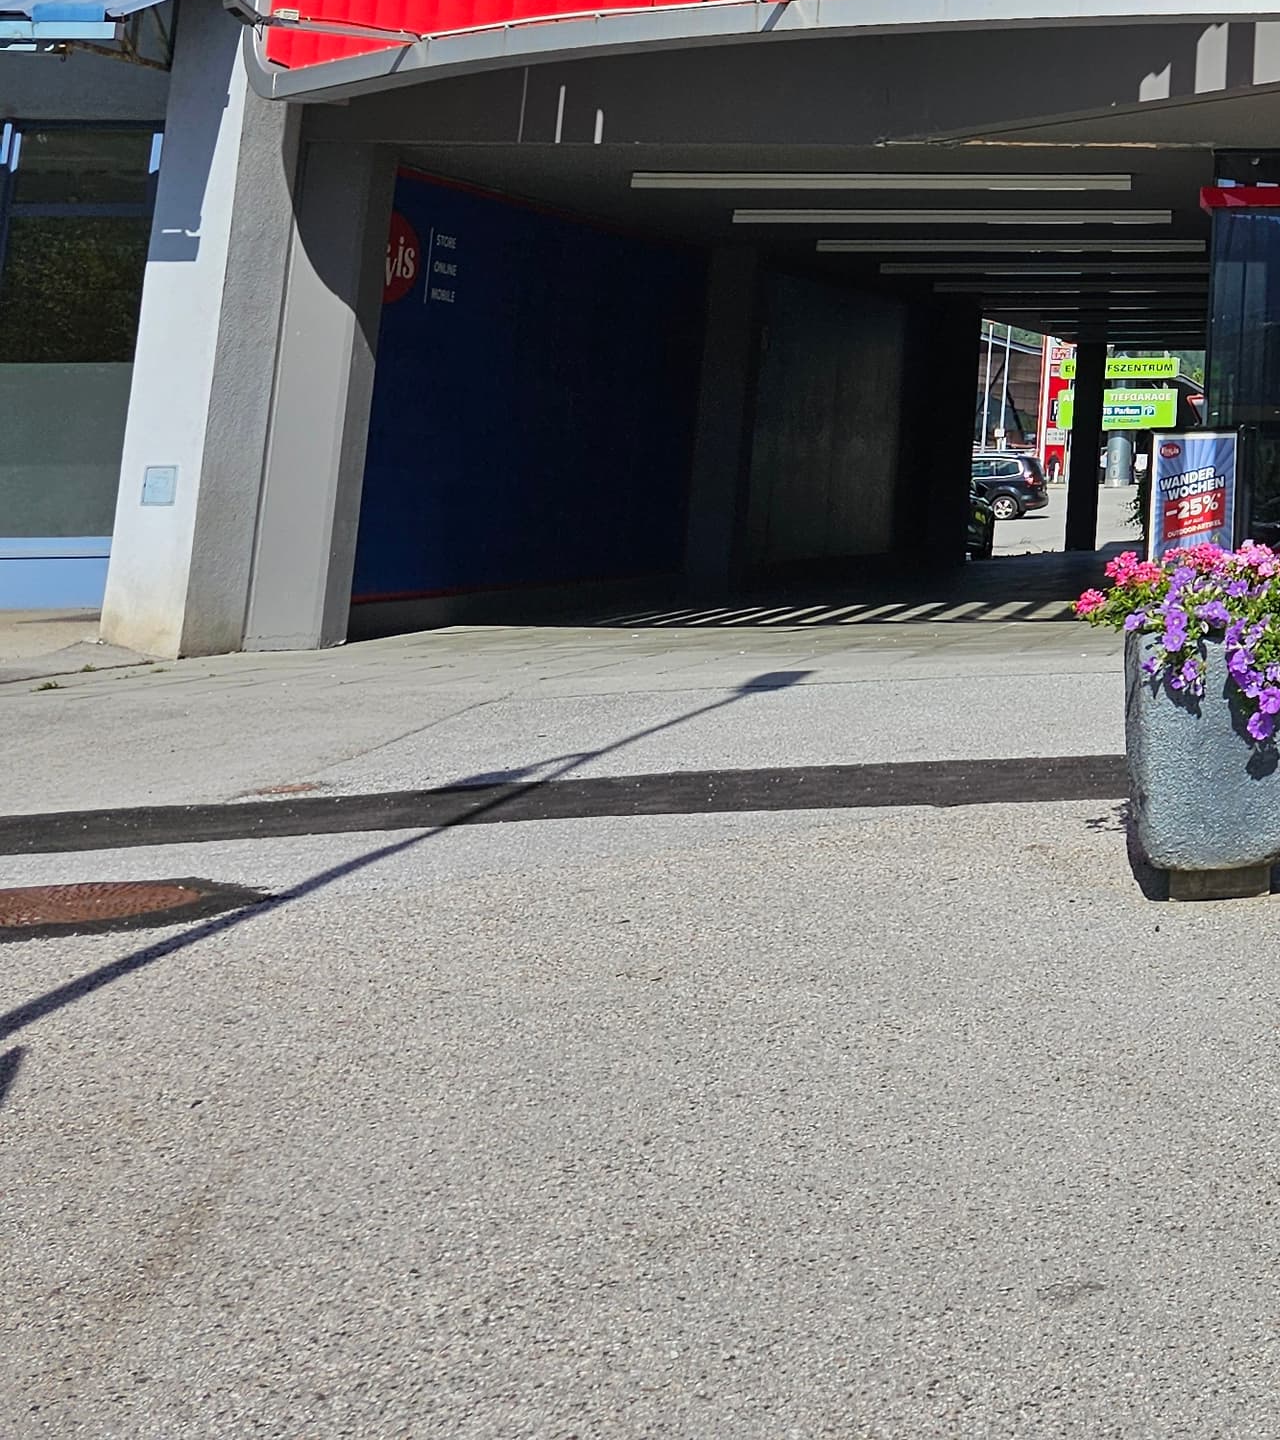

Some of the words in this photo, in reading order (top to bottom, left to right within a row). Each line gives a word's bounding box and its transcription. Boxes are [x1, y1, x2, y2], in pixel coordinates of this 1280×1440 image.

[436, 234, 457, 249] STORE
[385, 235, 416, 287] vis
[433, 261, 457, 277] ONLINE
[431, 287, 456, 303] MOBILE
[1161, 467, 1215, 490] WANDER
[1168, 476, 1224, 500] WOCHEN
